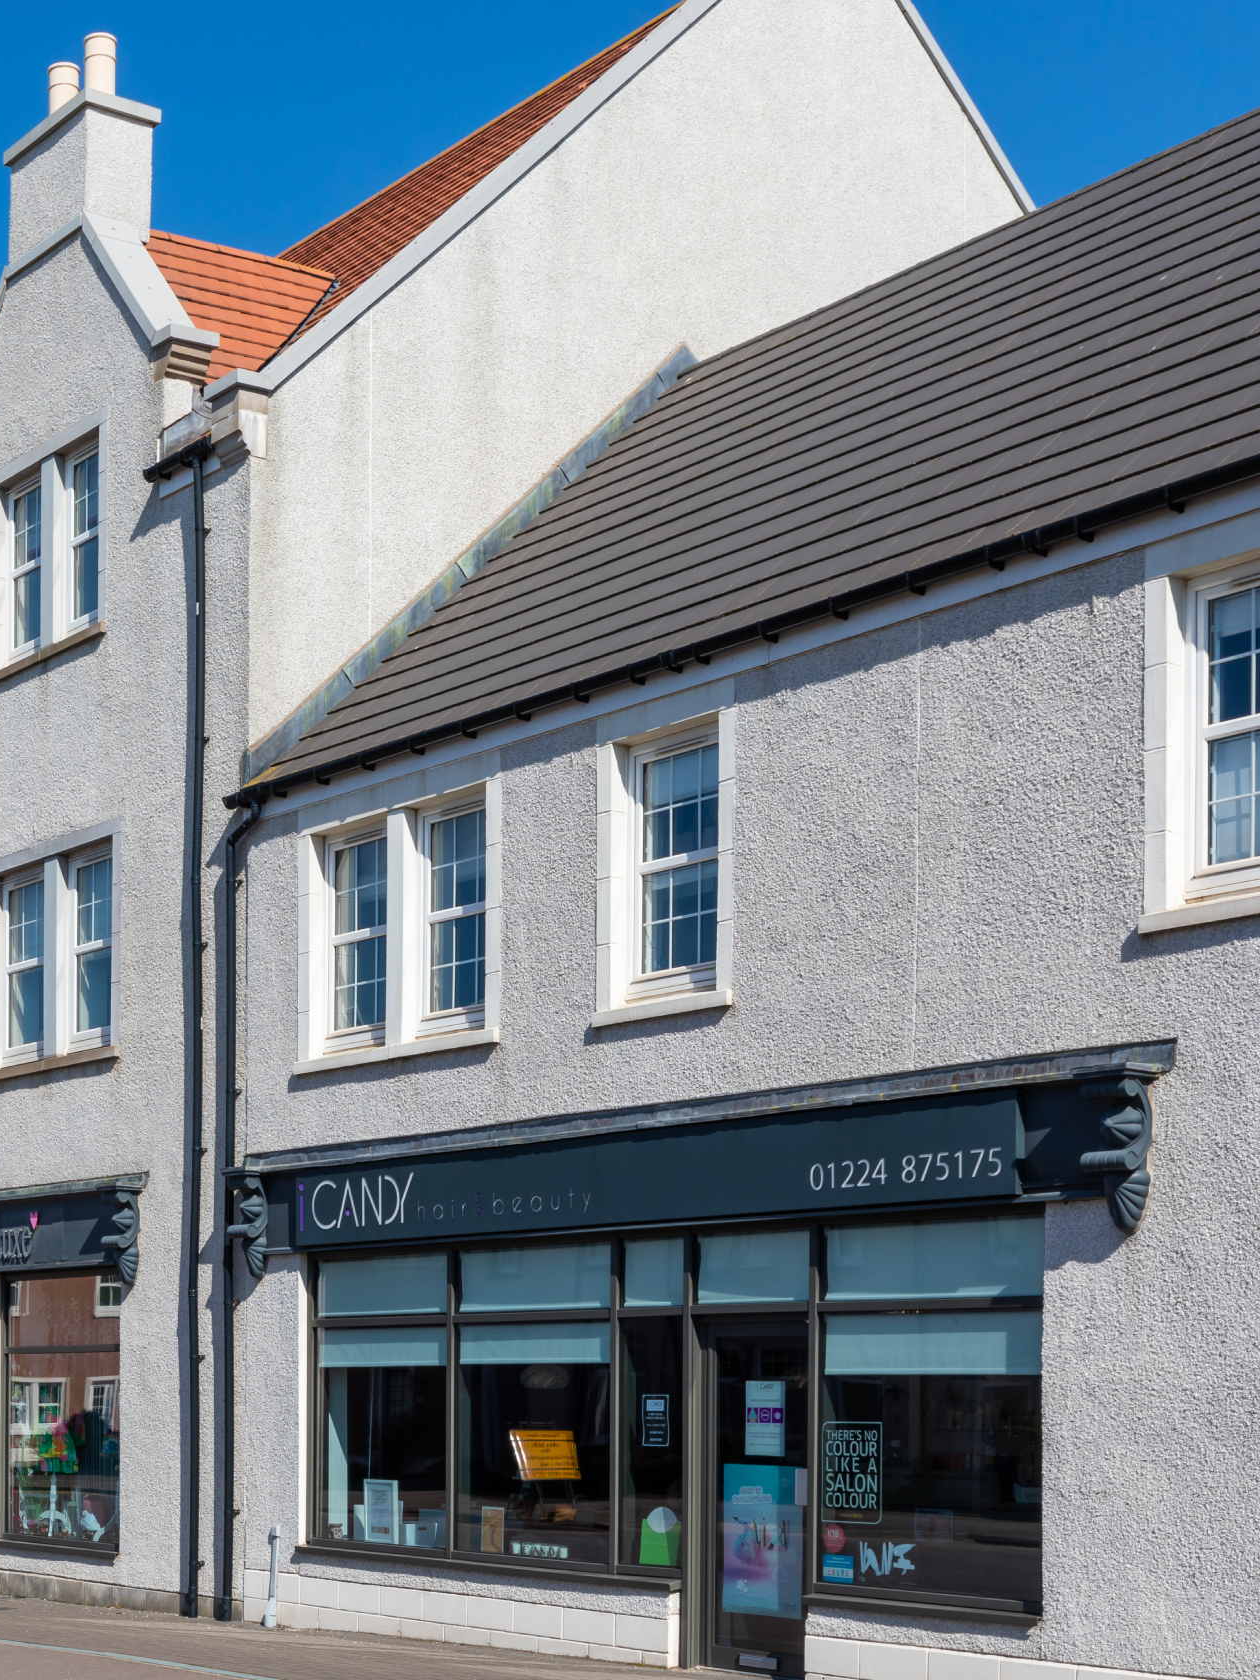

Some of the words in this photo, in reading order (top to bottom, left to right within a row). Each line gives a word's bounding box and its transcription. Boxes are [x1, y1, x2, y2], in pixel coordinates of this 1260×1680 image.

[809, 1157, 888, 1191] 01224
[901, 1147, 1002, 1183] 875175
[311, 1171, 415, 1230] CANDY
[825, 1429, 862, 1441] THERE'S
[864, 1430, 878, 1441] NO
[825, 1441, 878, 1457] COLOUR
[825, 1456, 860, 1473] LIKE
[867, 1457, 878, 1473] A
[825, 1473, 878, 1493] SALON
[732, 1495, 771, 1503] COLLECTION
[825, 1492, 877, 1509] COLOUR
[827, 1529, 840, 1539] K18
